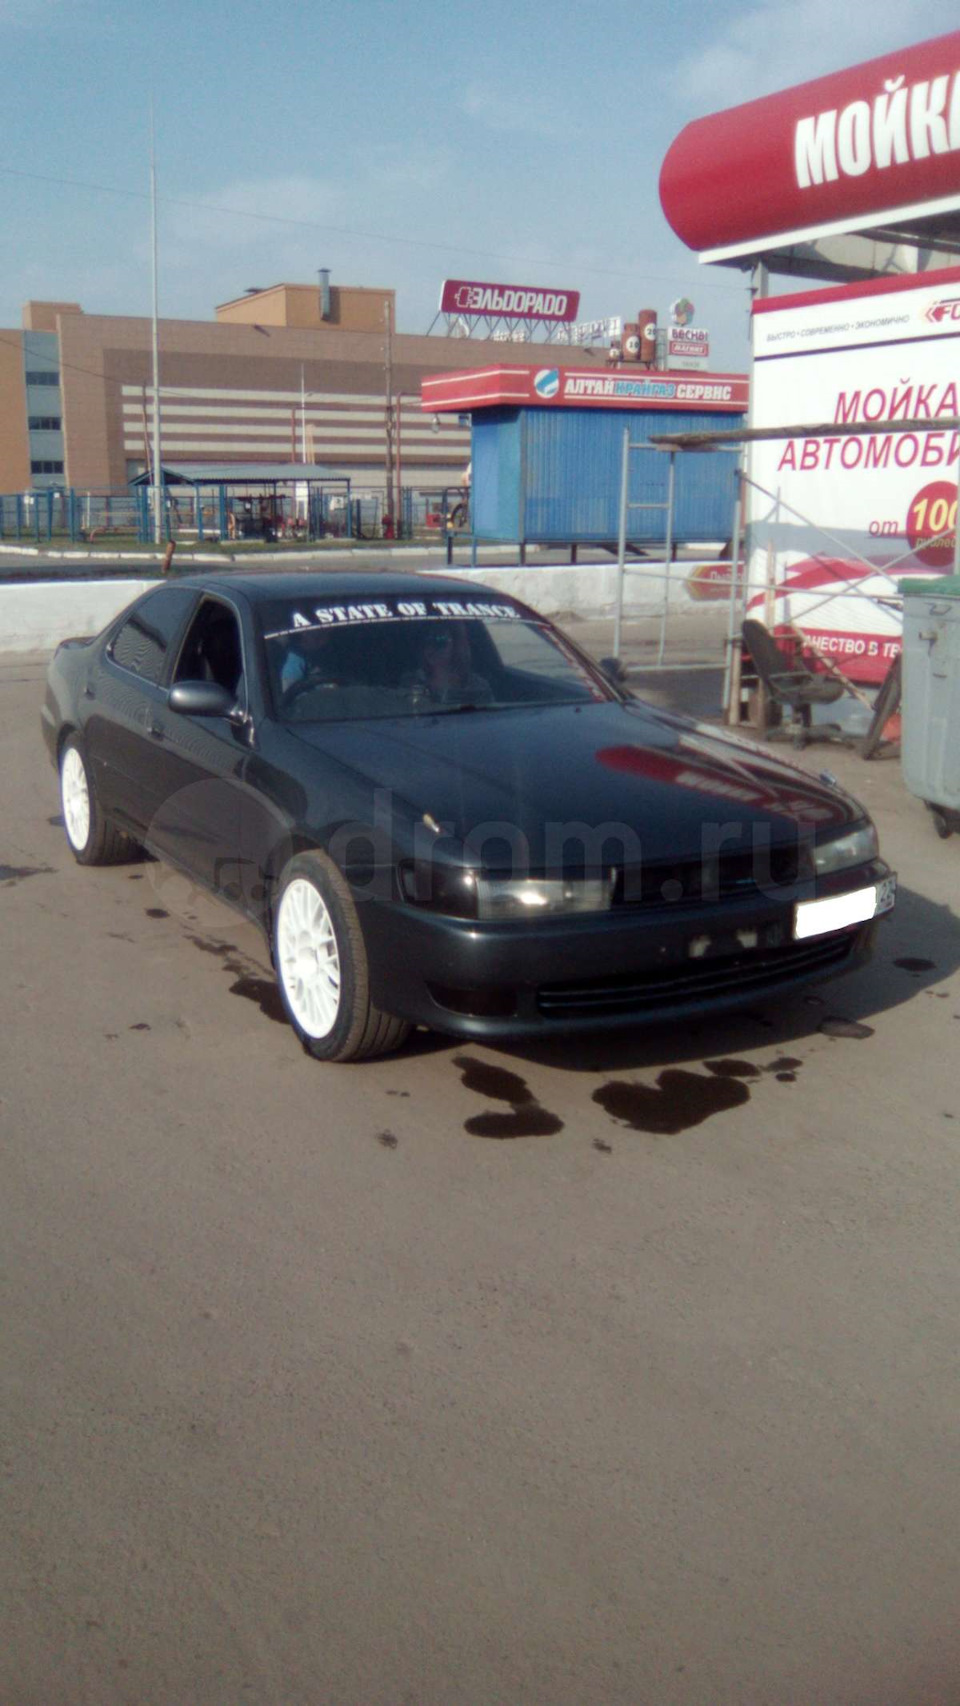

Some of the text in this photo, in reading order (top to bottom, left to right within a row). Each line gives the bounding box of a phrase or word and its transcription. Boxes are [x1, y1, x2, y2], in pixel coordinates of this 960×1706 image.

[794, 69, 960, 189] МОЙК
[834, 376, 958, 425] МОЙКА
[293, 601, 521, 628] A STATE OF TRANCE
